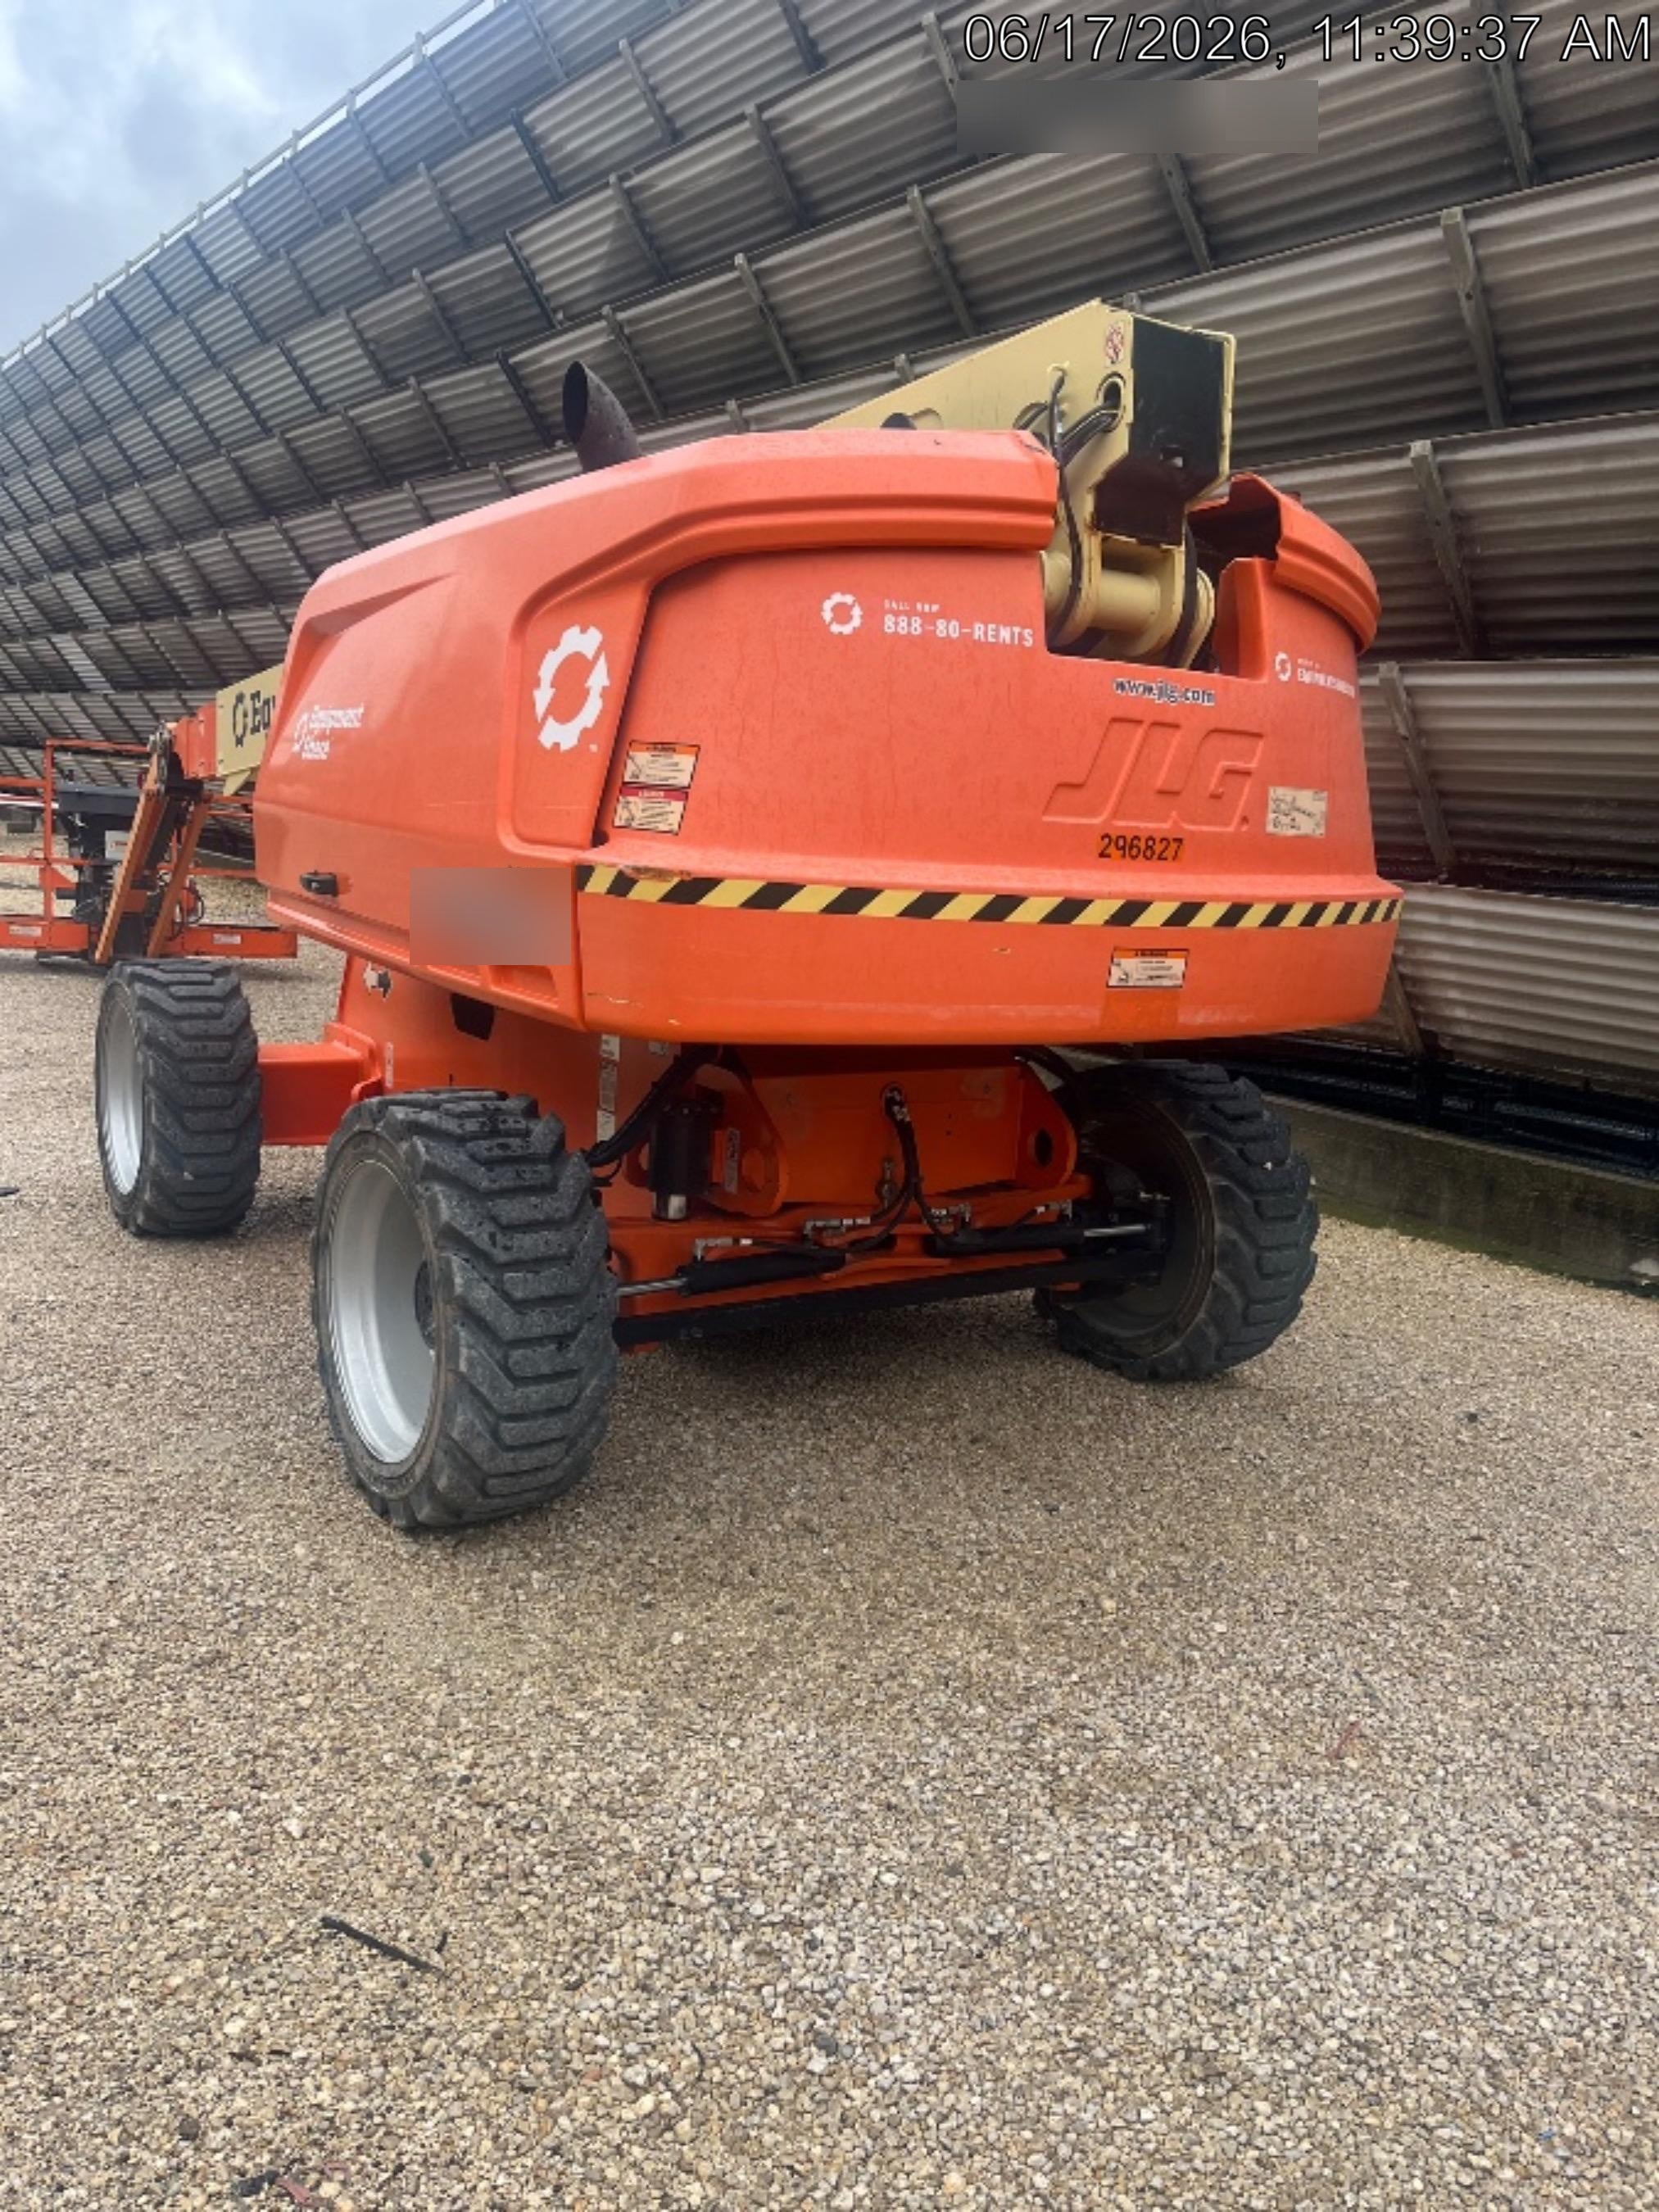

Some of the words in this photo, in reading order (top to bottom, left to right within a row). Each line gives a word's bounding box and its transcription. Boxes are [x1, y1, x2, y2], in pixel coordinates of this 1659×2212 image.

[883, 614, 1034, 647] 888-80-RENTS
[1113, 678, 1216, 706] www.jlg.com
[1041, 716, 1265, 832] JLG
[1098, 832, 1184, 862] 296827
